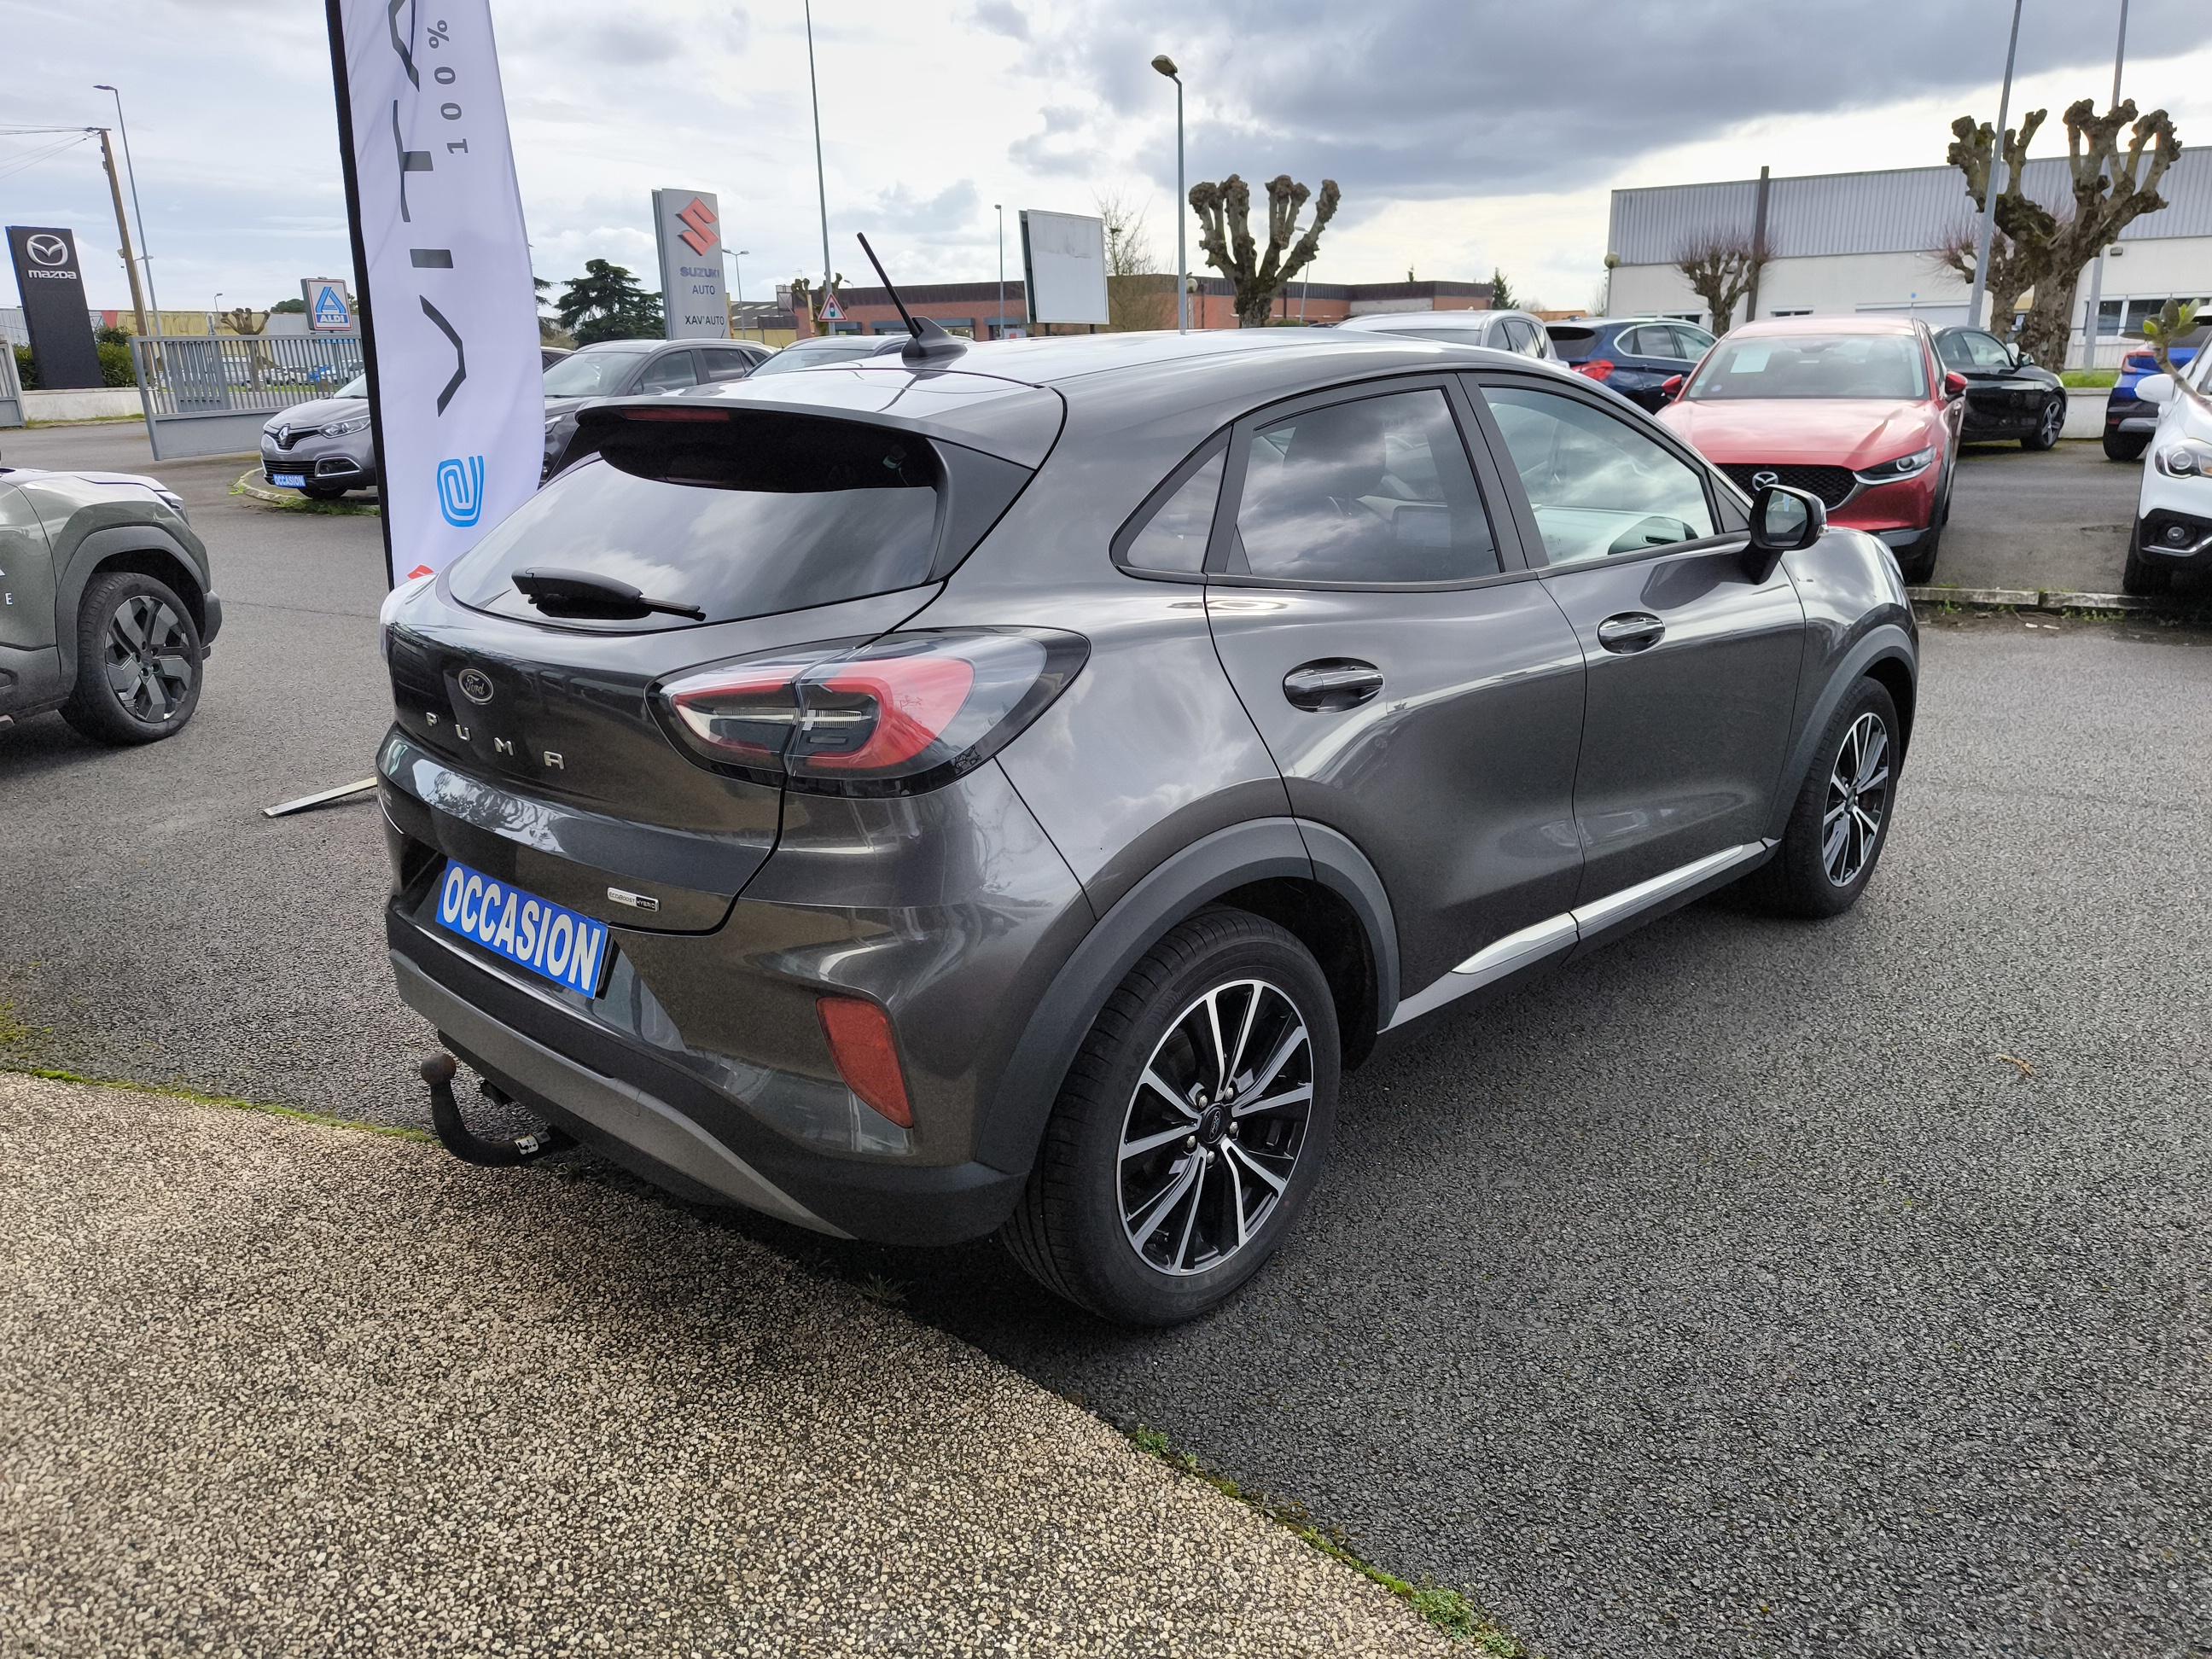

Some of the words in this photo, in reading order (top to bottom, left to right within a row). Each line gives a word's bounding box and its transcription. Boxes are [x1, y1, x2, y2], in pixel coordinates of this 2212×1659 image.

[27, 270, 77, 280] mazda
[679, 266, 720, 278] SUZUKI
[692, 284, 715, 295] AUTO
[319, 314, 346, 323] ALDI
[684, 316, 725, 326] XAV'AUTO
[274, 475, 306, 486] OCCASION
[464, 674, 486, 696] Ford
[442, 866, 601, 991] OCCASION
